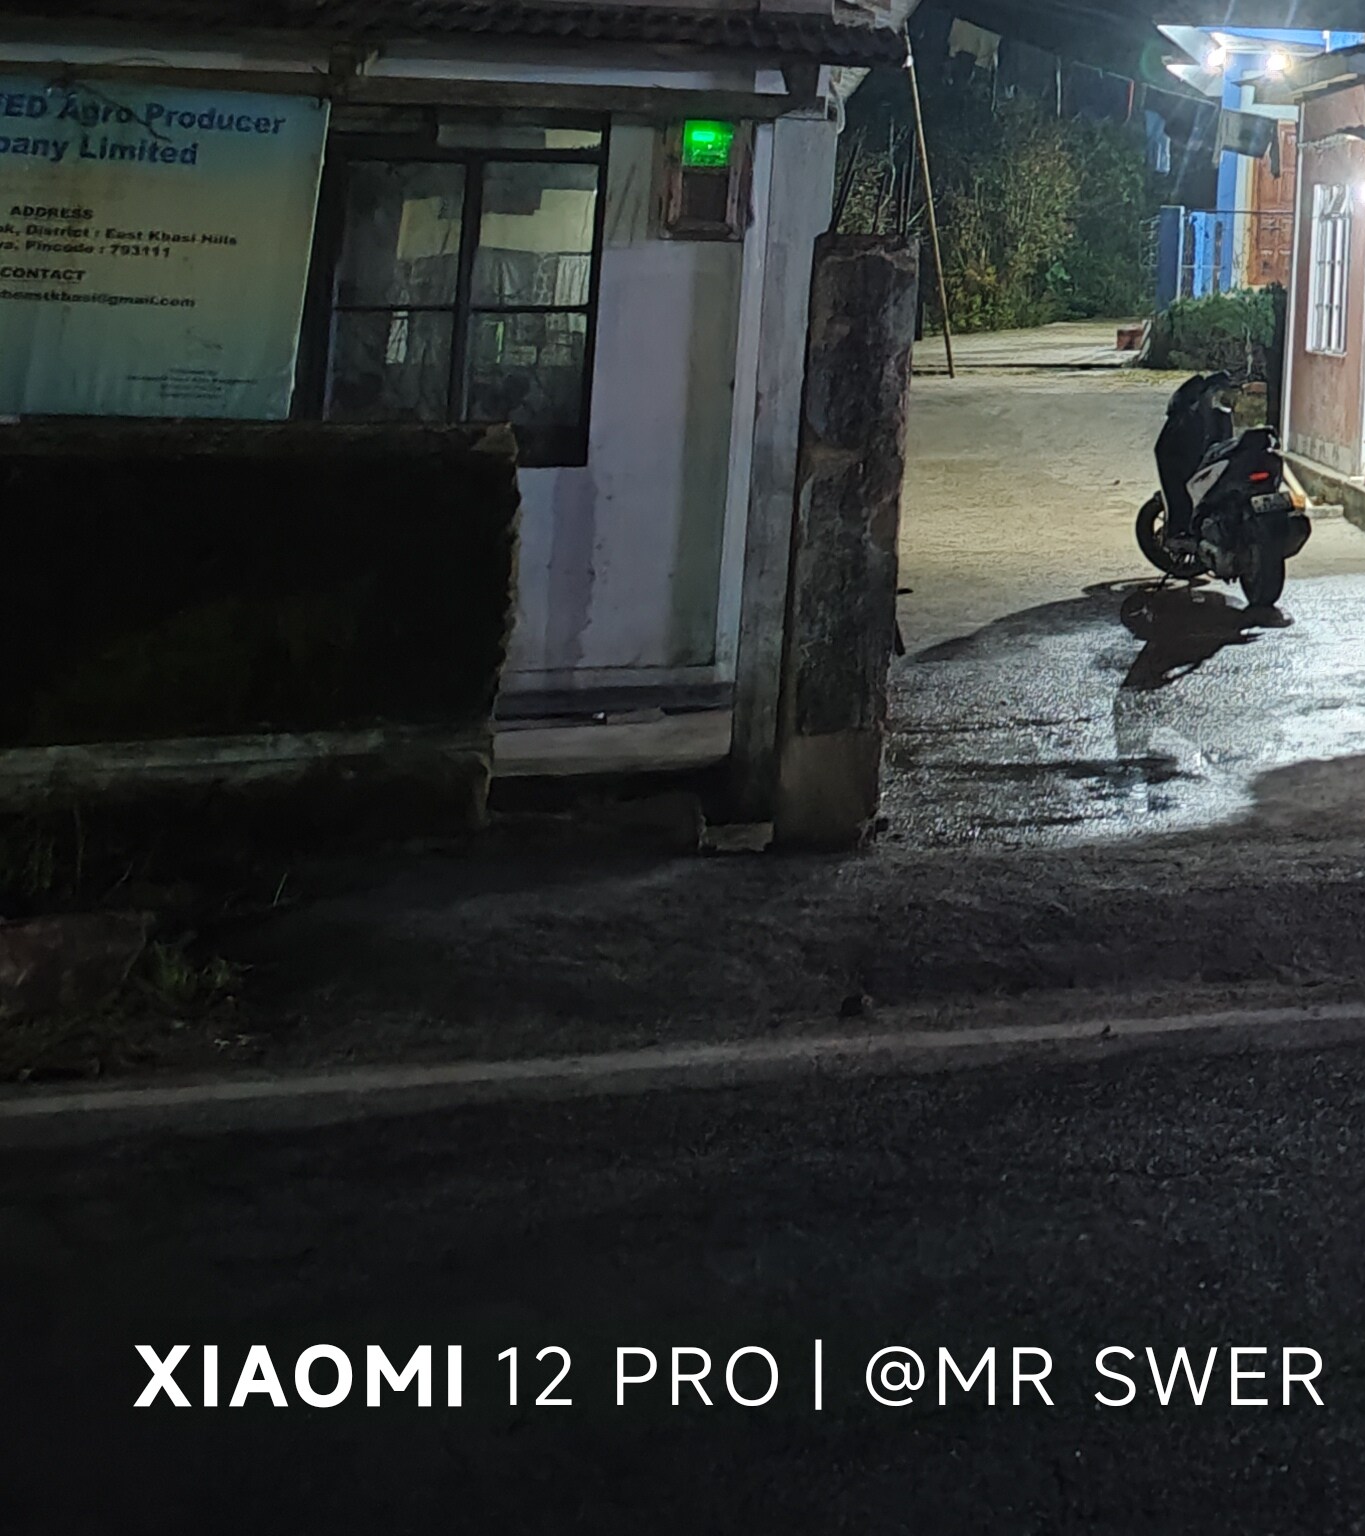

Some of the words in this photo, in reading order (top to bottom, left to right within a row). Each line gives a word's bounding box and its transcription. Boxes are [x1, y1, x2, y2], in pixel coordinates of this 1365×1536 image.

[0, 93, 48, 118] ED
[57, 93, 133, 128] Agro
[145, 102, 287, 135] Producer
[79, 136, 199, 165] Limited
[10, 205, 94, 220] ADDRESS
[26, 224, 89, 238] District
[105, 228, 143, 241] East
[0, 266, 86, 281] CONTACT
